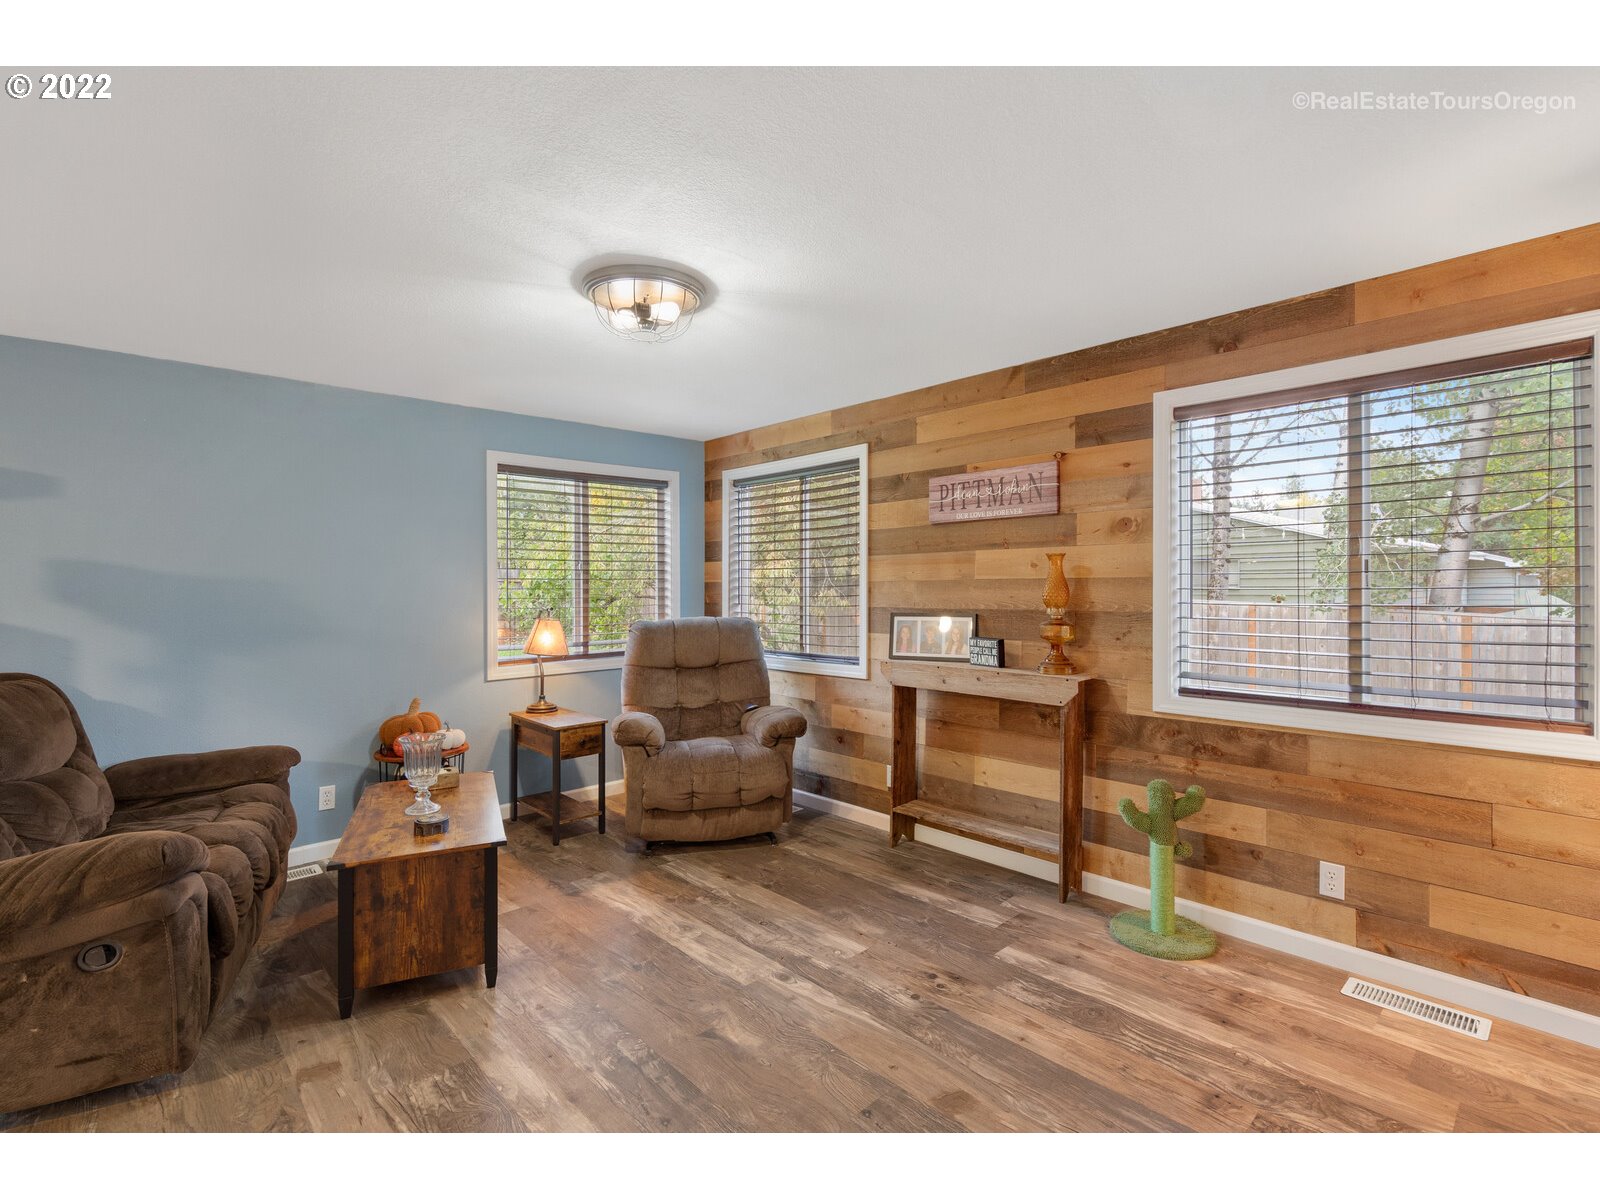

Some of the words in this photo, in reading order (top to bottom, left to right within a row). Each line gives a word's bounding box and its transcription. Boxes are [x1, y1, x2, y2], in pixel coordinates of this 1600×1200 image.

[939, 471, 1044, 512] PITTMAN
[956, 512, 969, 520] OUR
[969, 511, 985, 519] LOVE
[986, 510, 993, 518] IS
[993, 508, 1024, 517] FOREVER
[977, 640, 998, 648] FAVORITE
[970, 646, 983, 654] PEOPLE
[983, 647, 992, 655] CALL
[992, 648, 998, 656] ME
[970, 654, 998, 667] GRANDMA
